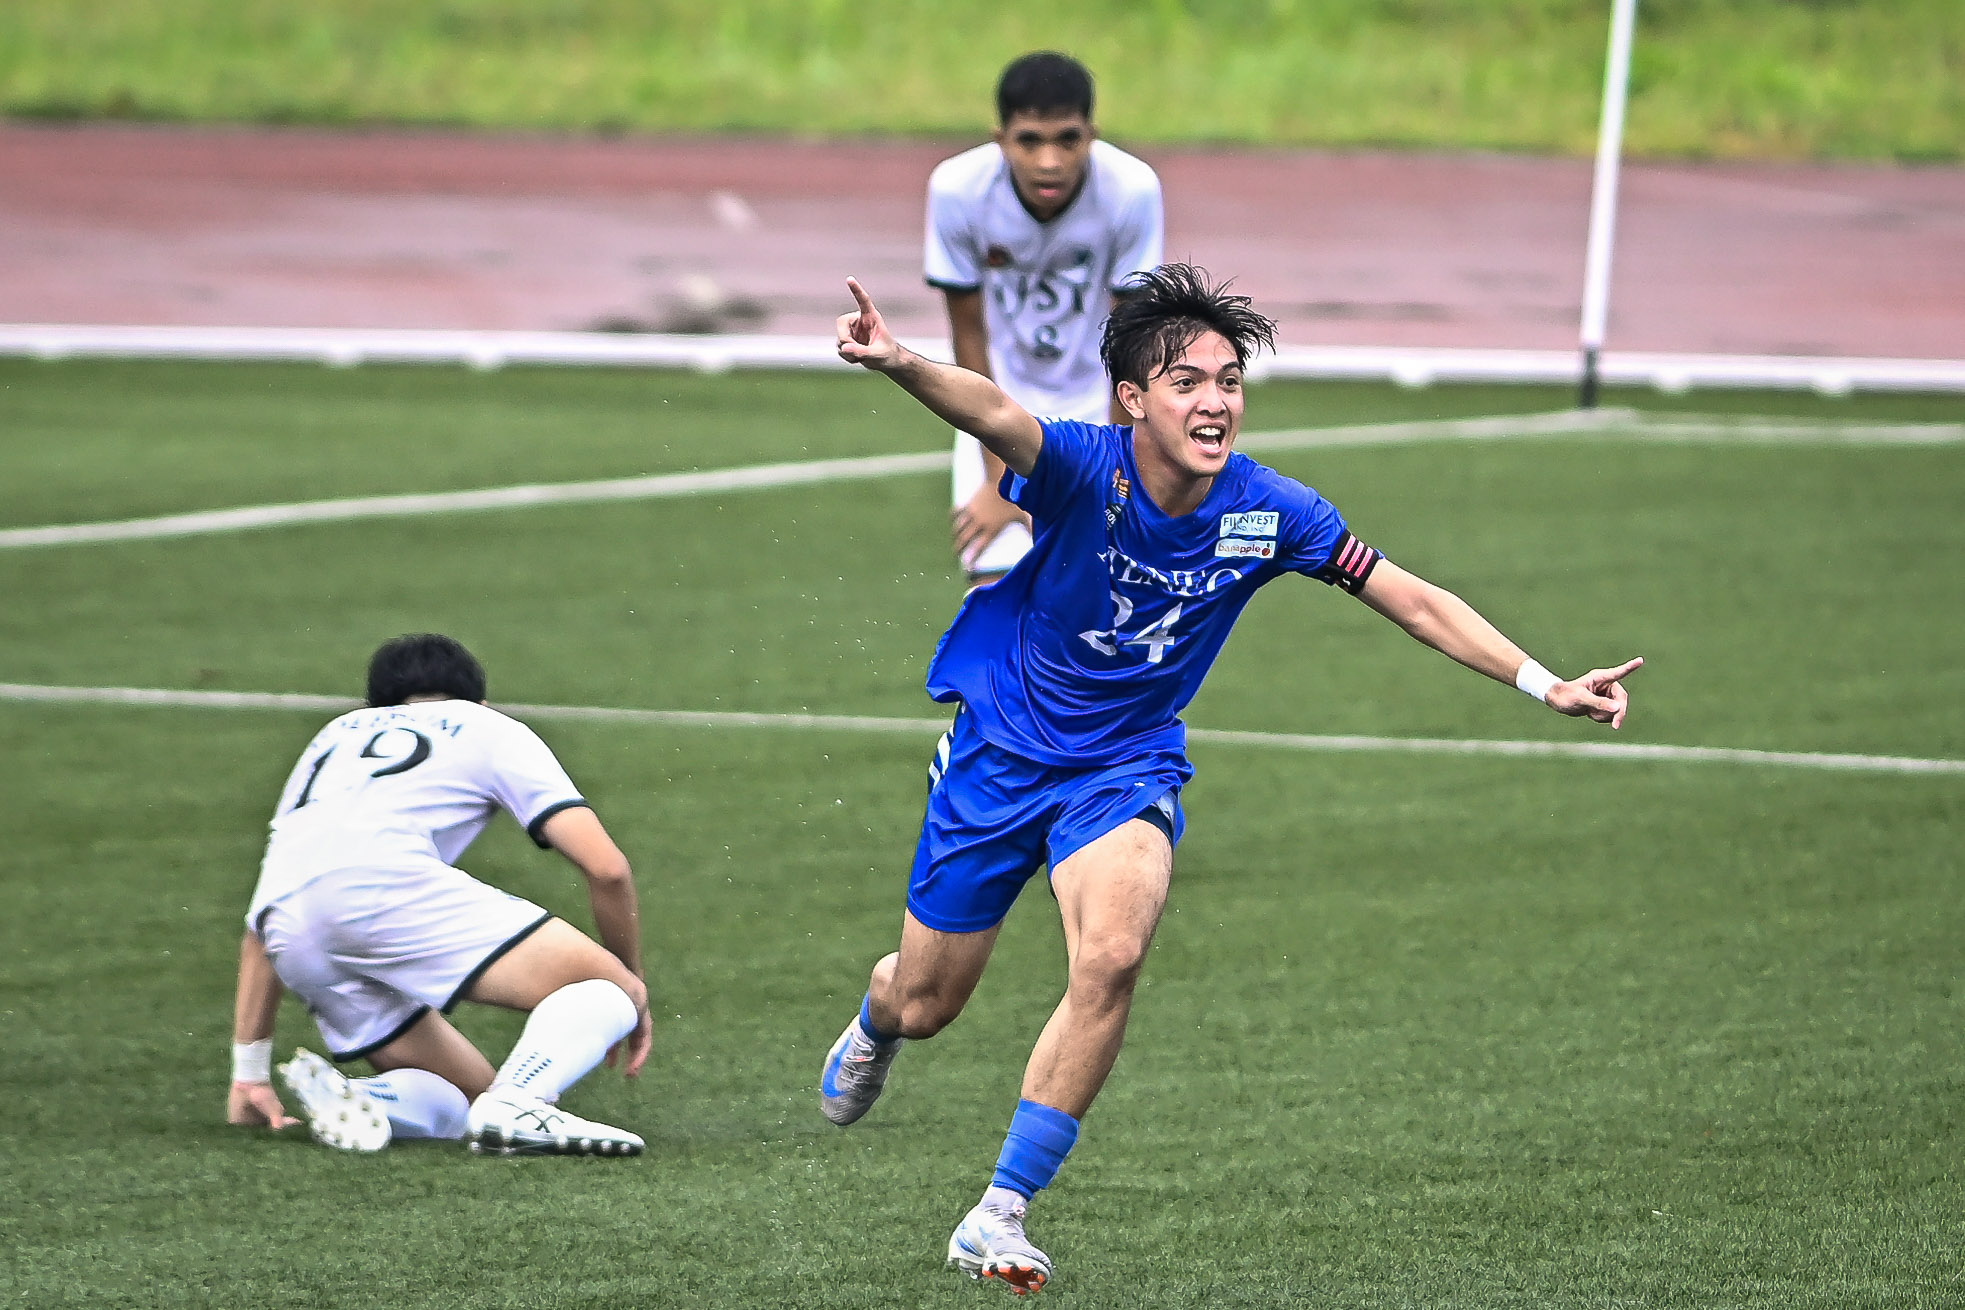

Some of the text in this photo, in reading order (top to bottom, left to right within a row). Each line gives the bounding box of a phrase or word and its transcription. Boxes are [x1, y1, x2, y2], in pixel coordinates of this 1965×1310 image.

[1032, 324, 1063, 358] 8
[1223, 514, 1276, 527] FILNVEST
[1078, 590, 1183, 664] 24
[287, 727, 433, 814] 19
